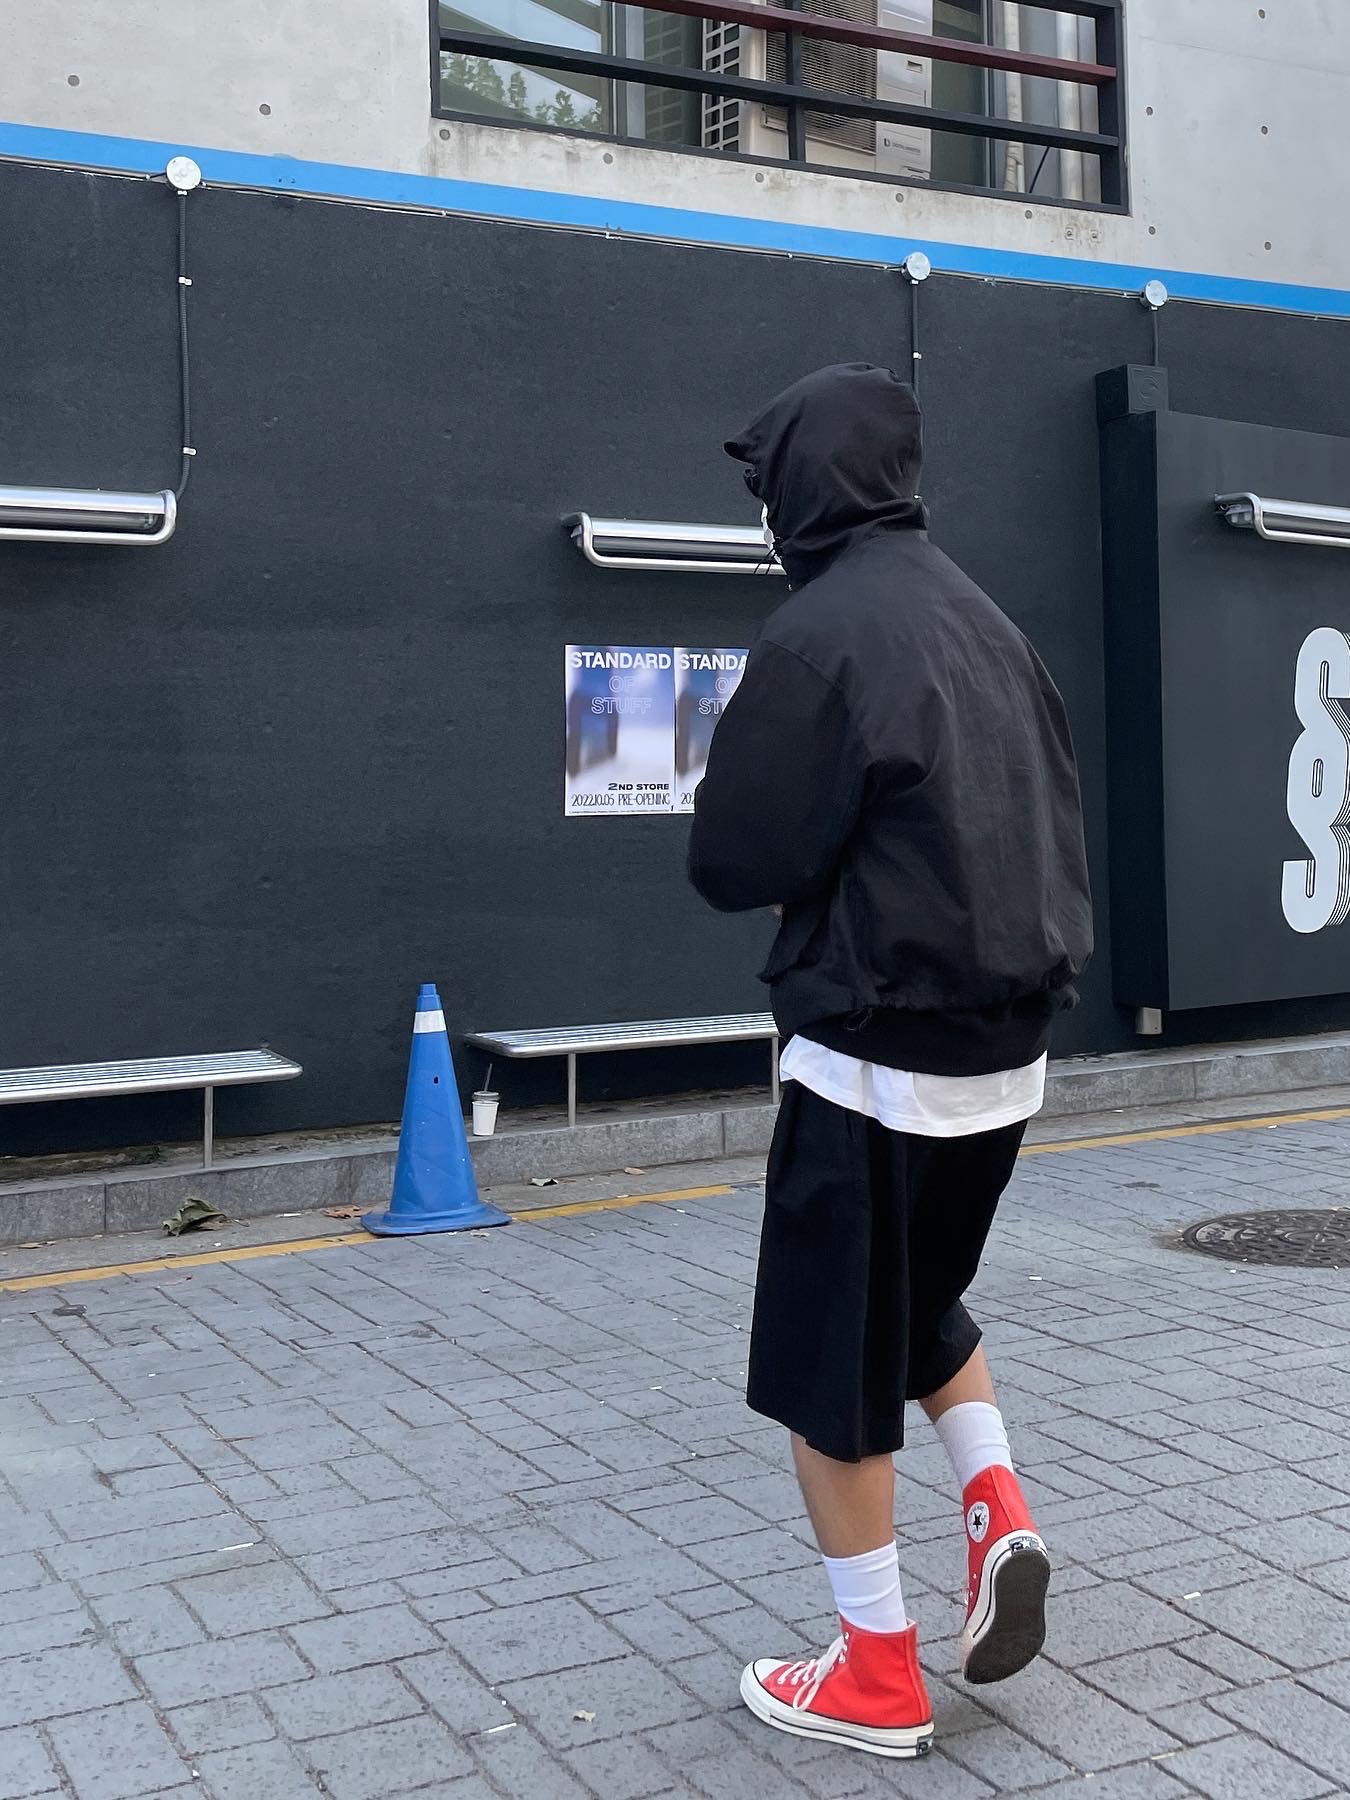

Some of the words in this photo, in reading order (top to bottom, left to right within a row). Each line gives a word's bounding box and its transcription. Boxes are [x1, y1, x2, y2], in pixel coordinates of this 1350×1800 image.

[570, 652, 671, 670] STANDARD
[609, 676, 638, 693] OF
[591, 697, 652, 715] STUFF
[608, 782, 634, 791] 2ND
[636, 783, 670, 791] STORE
[618, 792, 671, 806] PRE-OPENING
